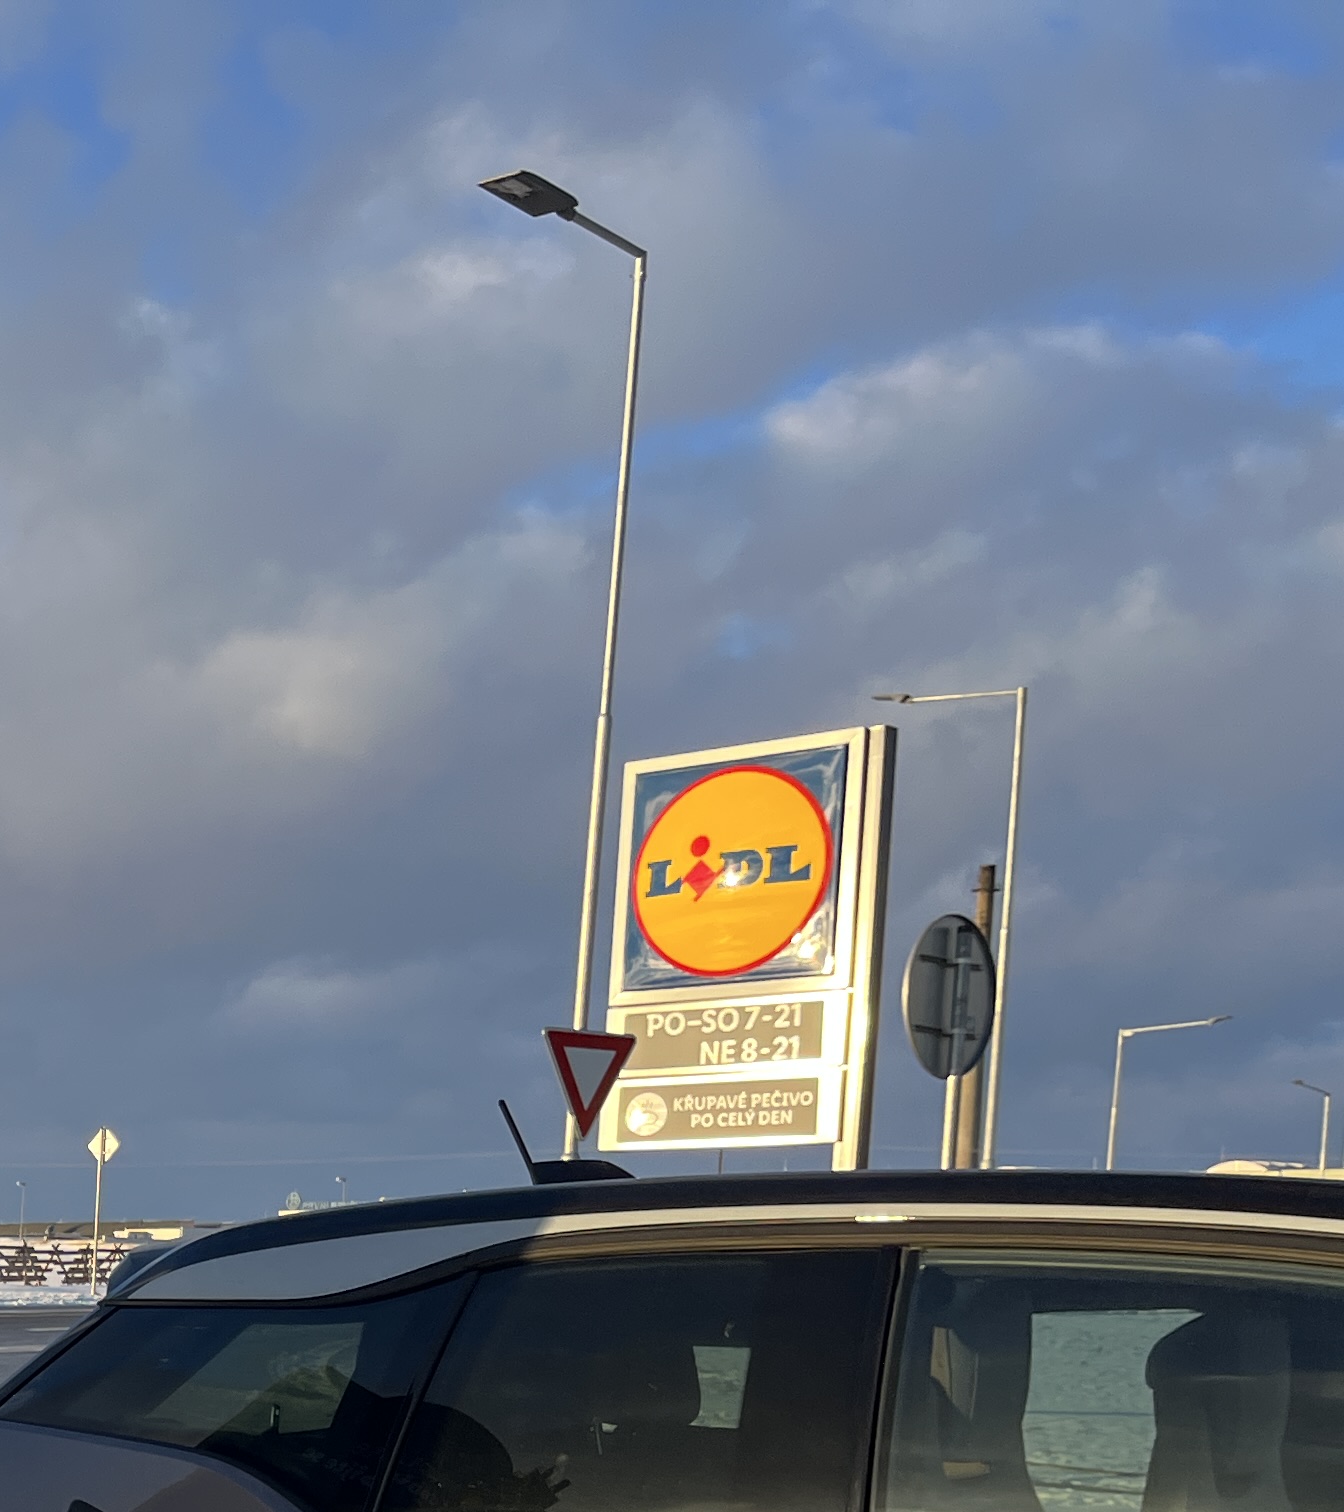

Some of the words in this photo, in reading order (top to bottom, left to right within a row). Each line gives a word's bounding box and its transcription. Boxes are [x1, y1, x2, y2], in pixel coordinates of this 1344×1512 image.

[699, 1039, 737, 1065] NE
[673, 1091, 747, 1112] KŘUPAVÉ
[751, 1089, 814, 1109] PEČIVO
[690, 1113, 714, 1128] PO
[717, 1108, 756, 1127] CELÝ
[758, 1110, 793, 1125] DEN
